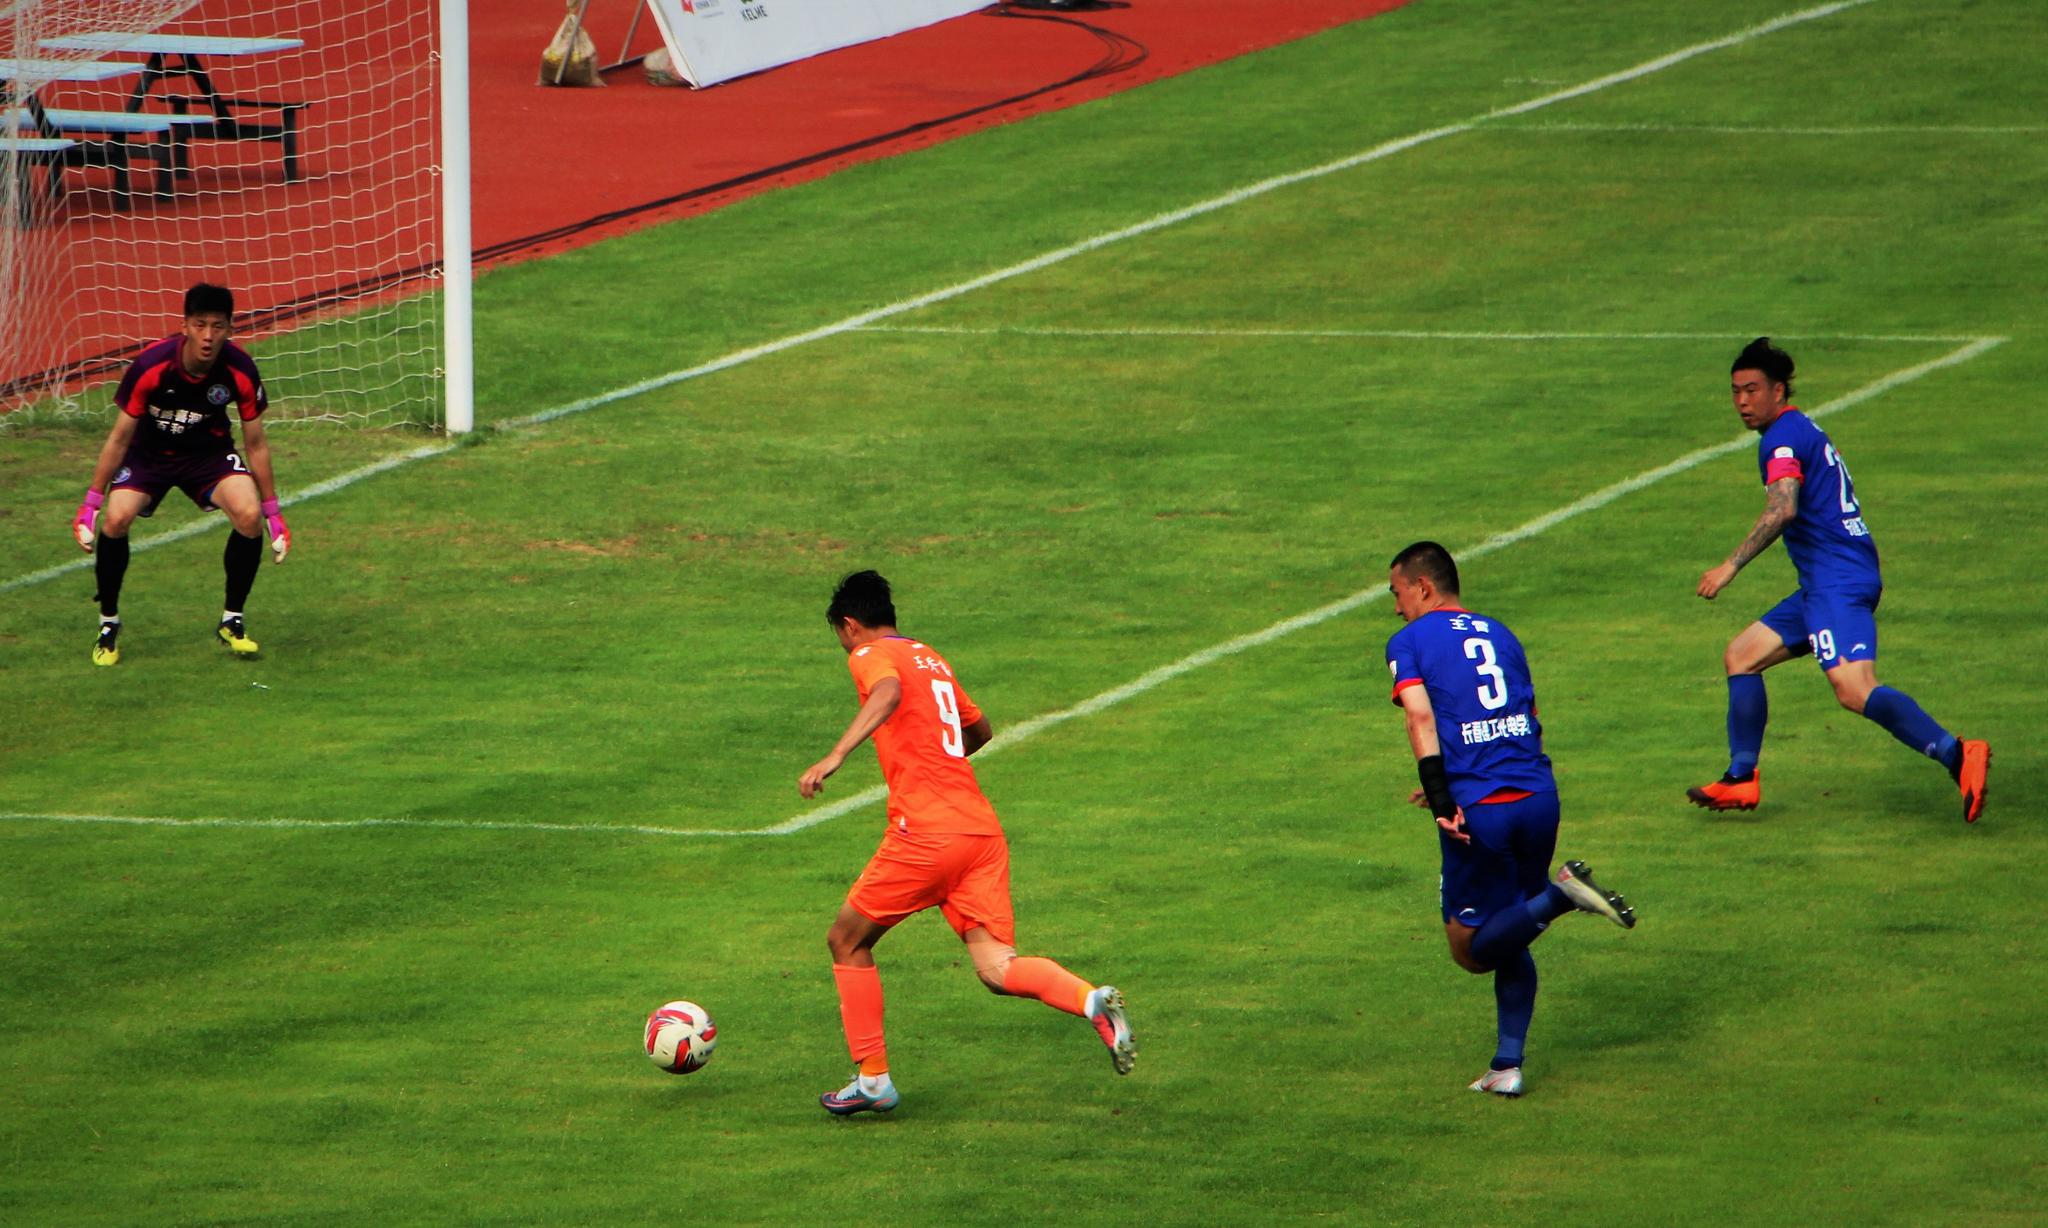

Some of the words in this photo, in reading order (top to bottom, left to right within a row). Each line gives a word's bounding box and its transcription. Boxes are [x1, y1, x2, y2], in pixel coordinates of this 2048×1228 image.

[741, 6, 768, 22] KELME
[1808, 628, 1837, 664] 29
[1463, 637, 1508, 711] 3
[931, 678, 965, 758] 9
